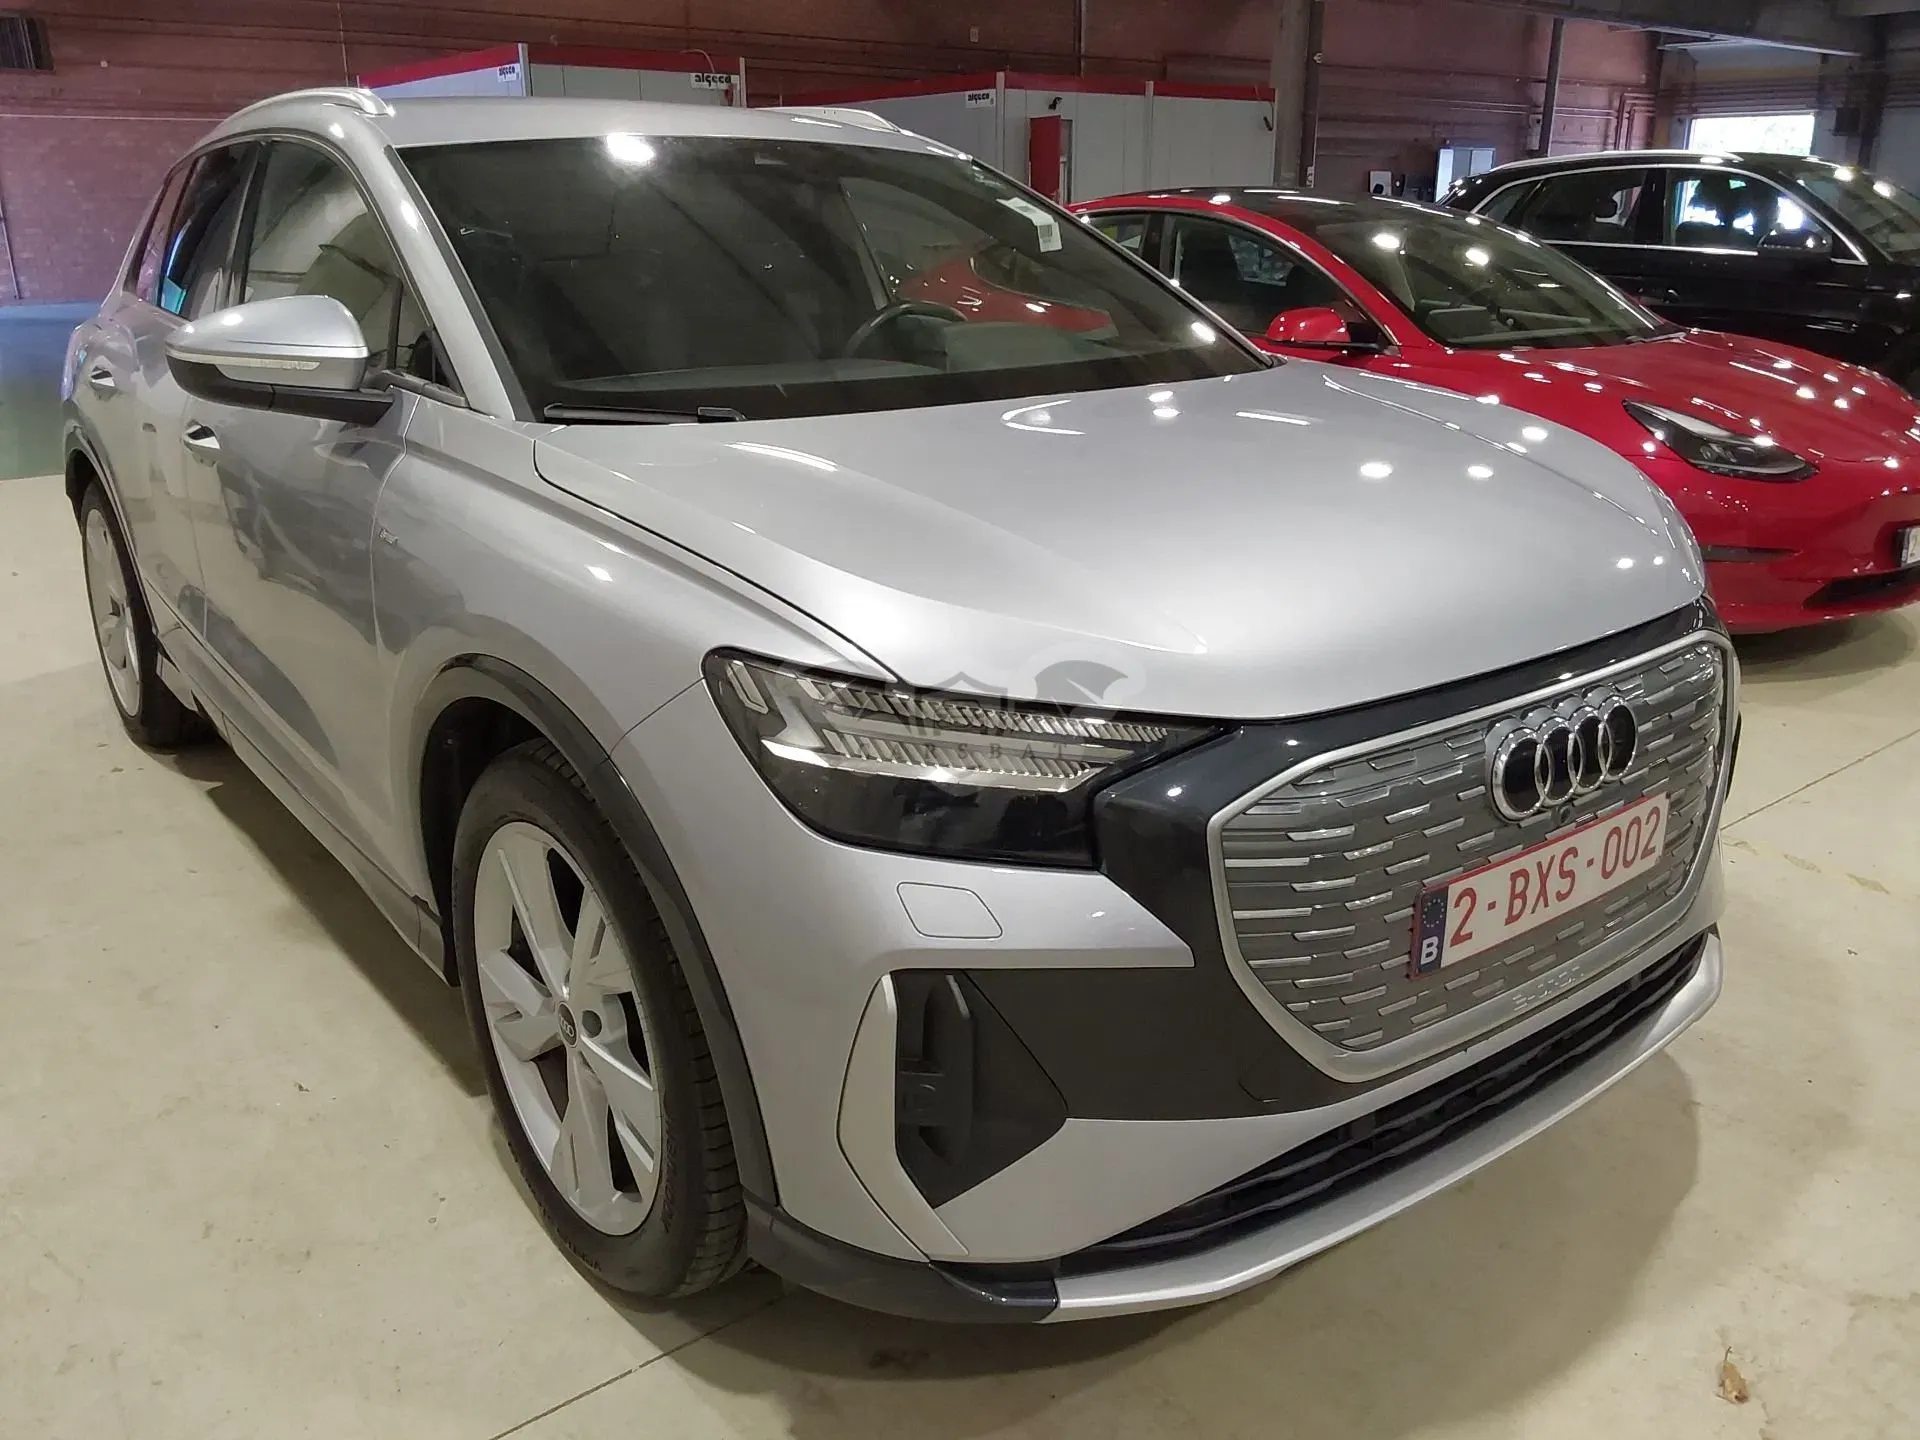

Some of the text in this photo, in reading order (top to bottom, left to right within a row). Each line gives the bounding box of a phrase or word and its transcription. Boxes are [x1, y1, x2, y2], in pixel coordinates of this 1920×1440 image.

[694, 72, 732, 88] algeco
[1449, 806, 1661, 948] 2-BXS-002
[1420, 936, 1439, 966] B
